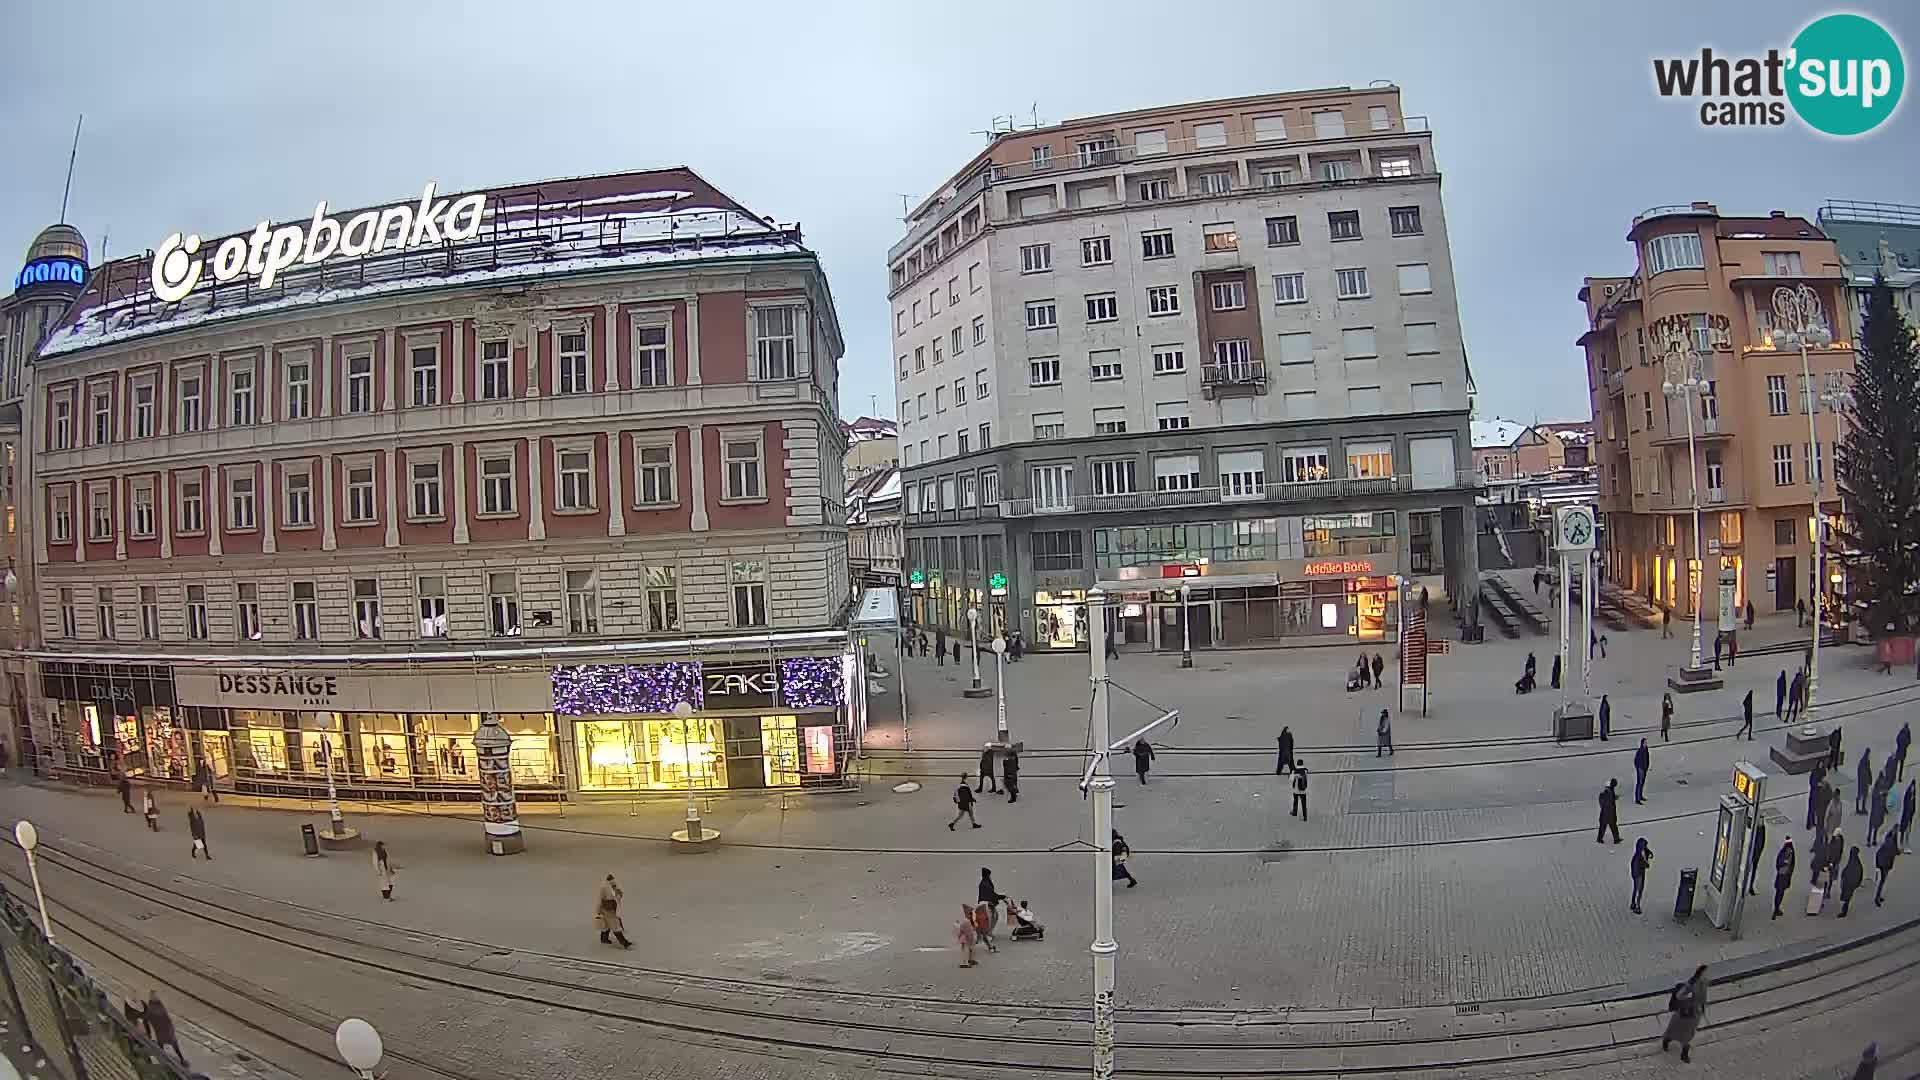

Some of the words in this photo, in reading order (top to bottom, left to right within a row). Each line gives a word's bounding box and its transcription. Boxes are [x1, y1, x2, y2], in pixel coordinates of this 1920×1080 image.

[22, 261, 83, 285] nama
[220, 673, 337, 696] DESSANGE
[706, 673, 779, 695] ZAKS
